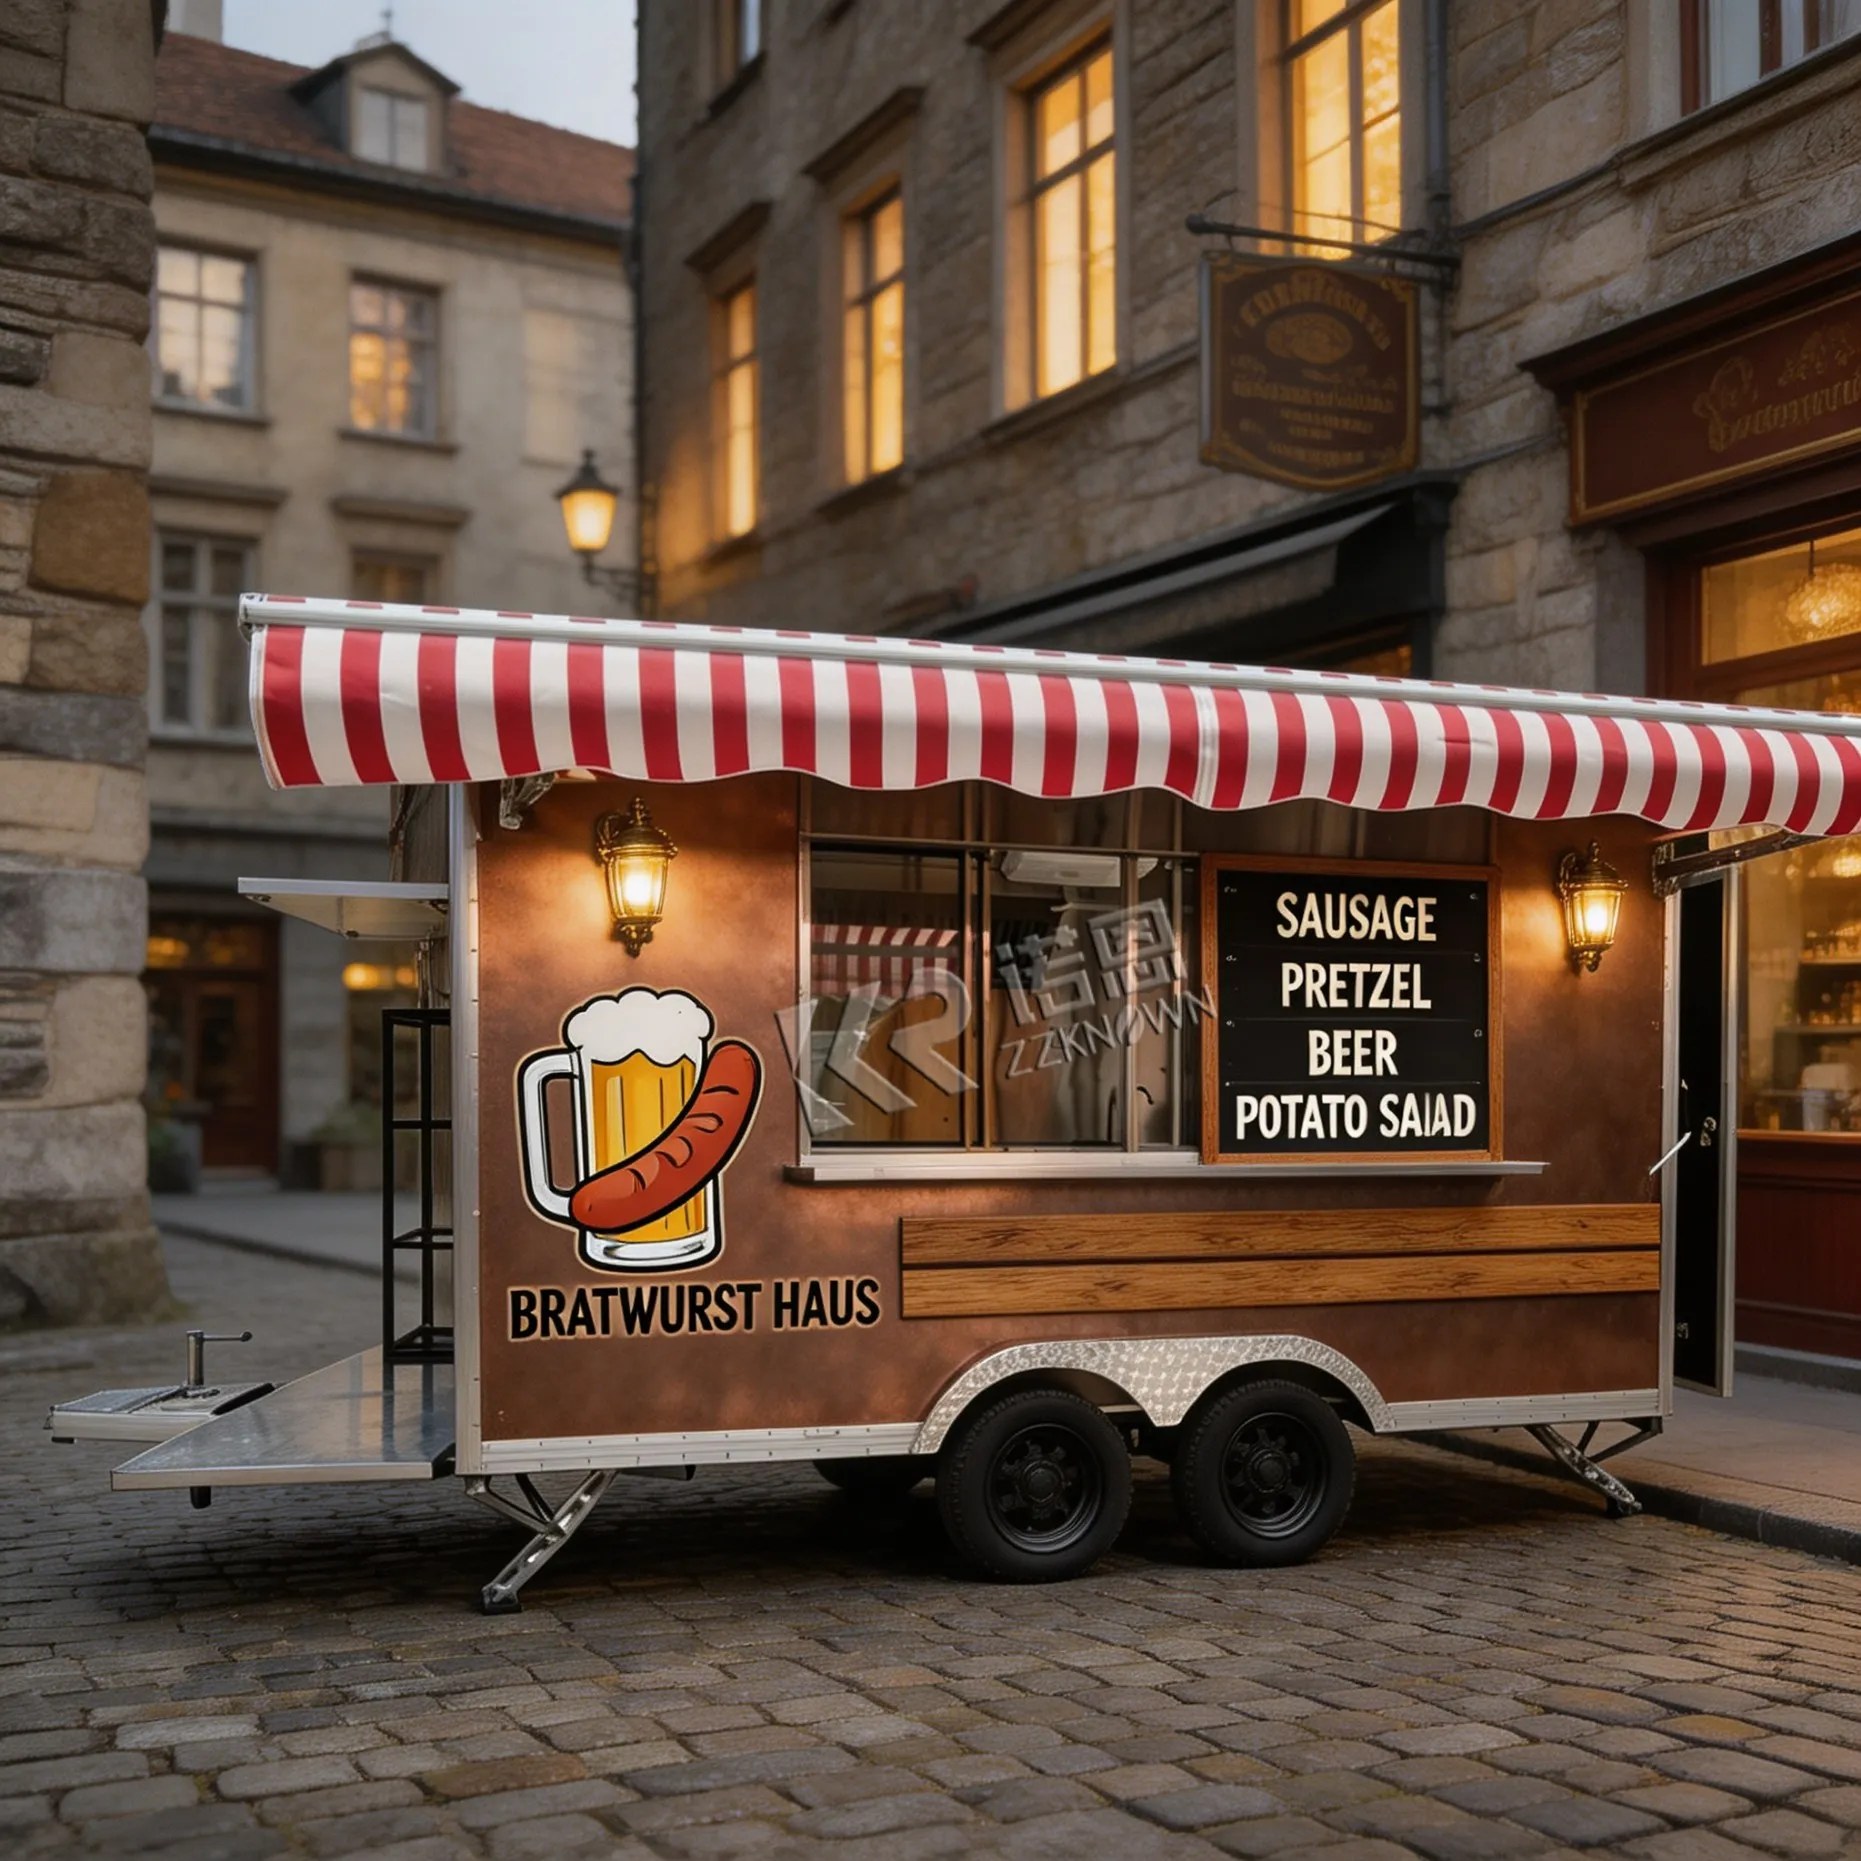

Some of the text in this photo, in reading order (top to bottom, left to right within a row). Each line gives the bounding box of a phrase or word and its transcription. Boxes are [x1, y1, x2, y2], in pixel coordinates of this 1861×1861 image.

[1276, 891, 1438, 942] SAUSAGE
[1281, 962, 1432, 1009] PRETZEL
[1308, 1029, 1399, 1076] BEER
[1236, 1094, 1368, 1140] POTATO
[509, 1278, 881, 1339] BRATWURST HAUS
